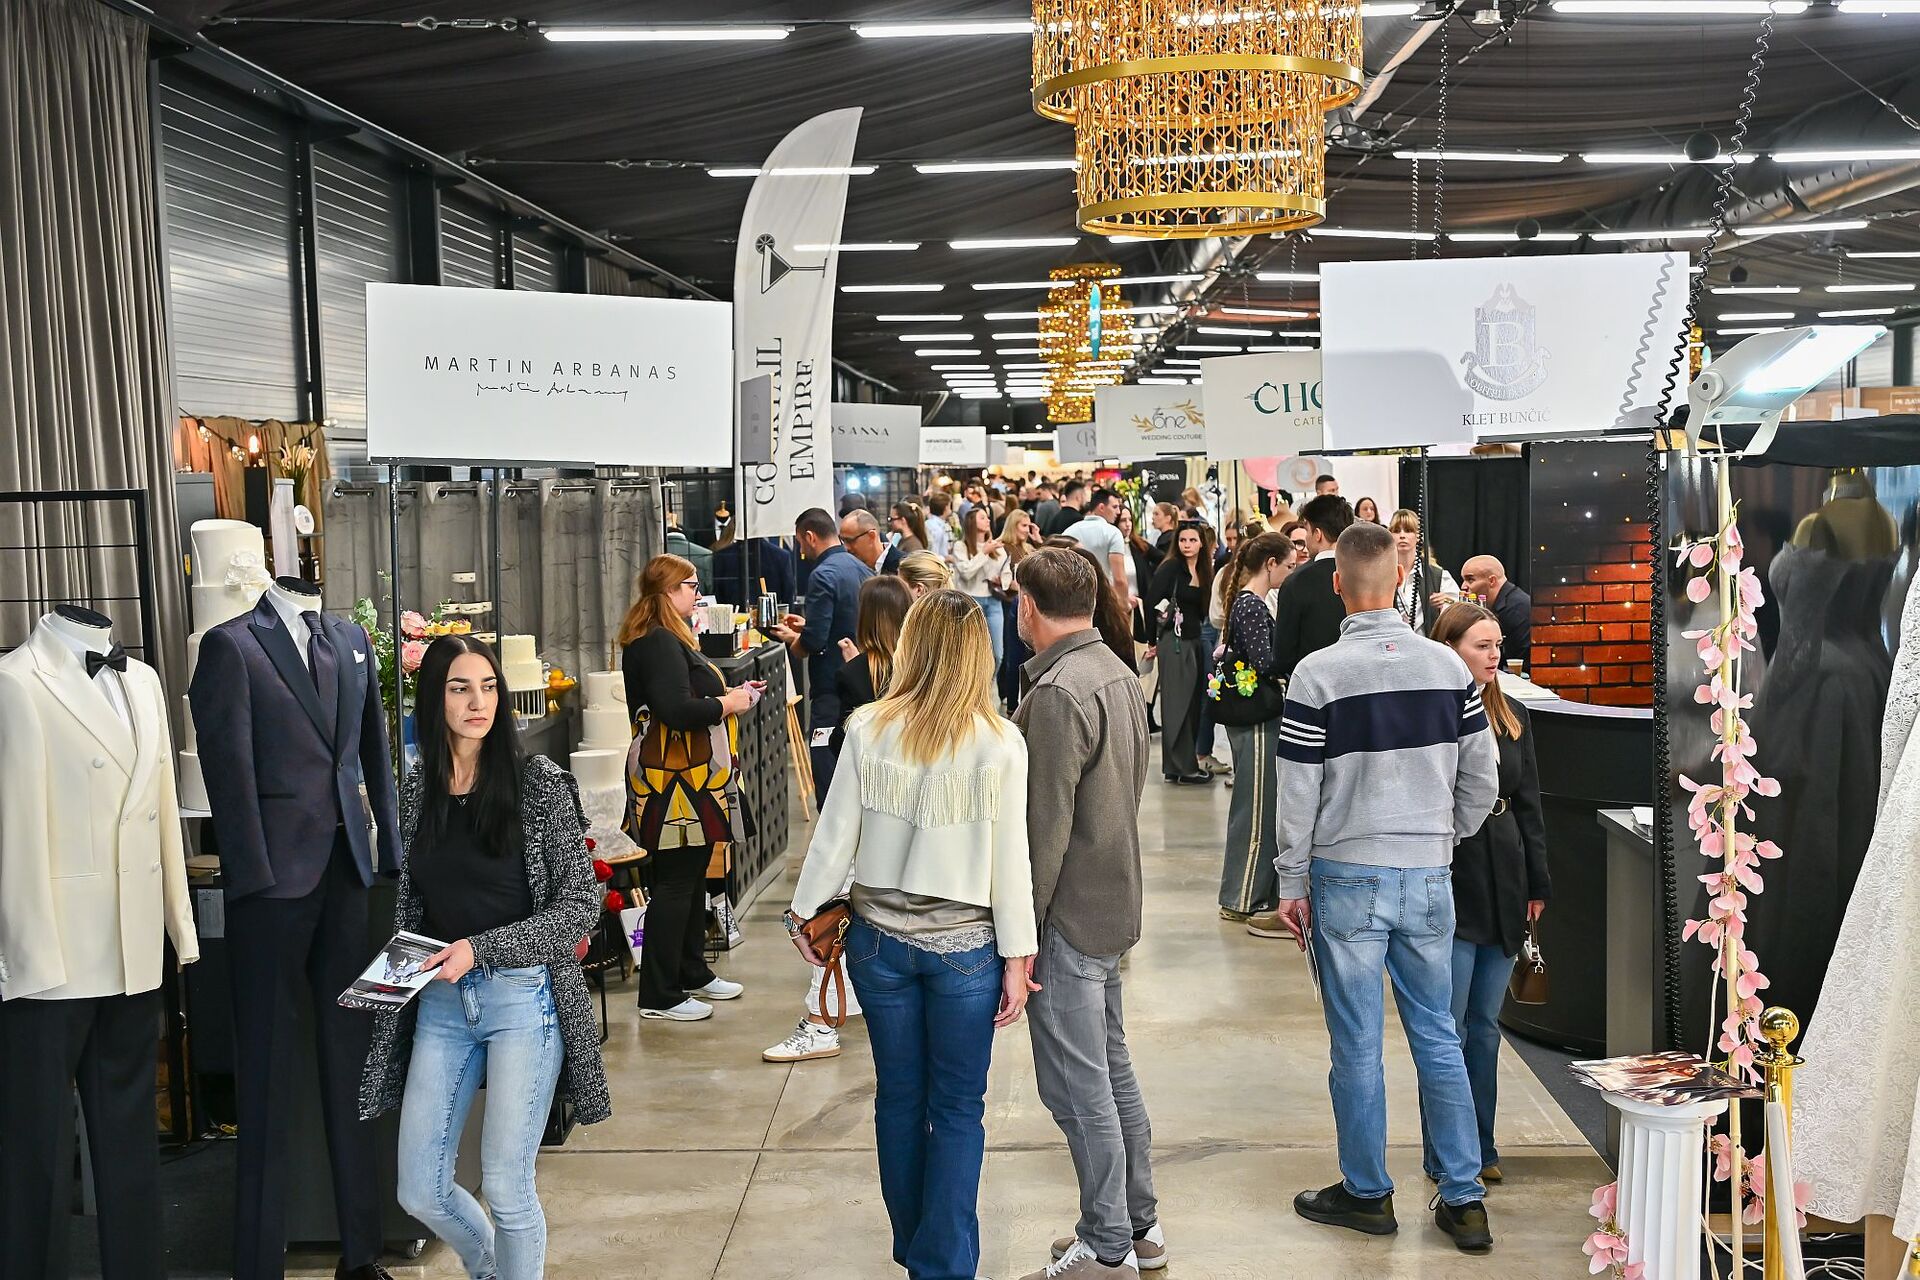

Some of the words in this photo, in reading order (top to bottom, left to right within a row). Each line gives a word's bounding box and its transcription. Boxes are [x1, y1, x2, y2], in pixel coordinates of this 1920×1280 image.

[424, 355, 532, 375] MARTIN
[552, 361, 677, 380] ARBANAS
[789, 358, 815, 482] EMPIRE
[1462, 413, 1496, 426] KLET
